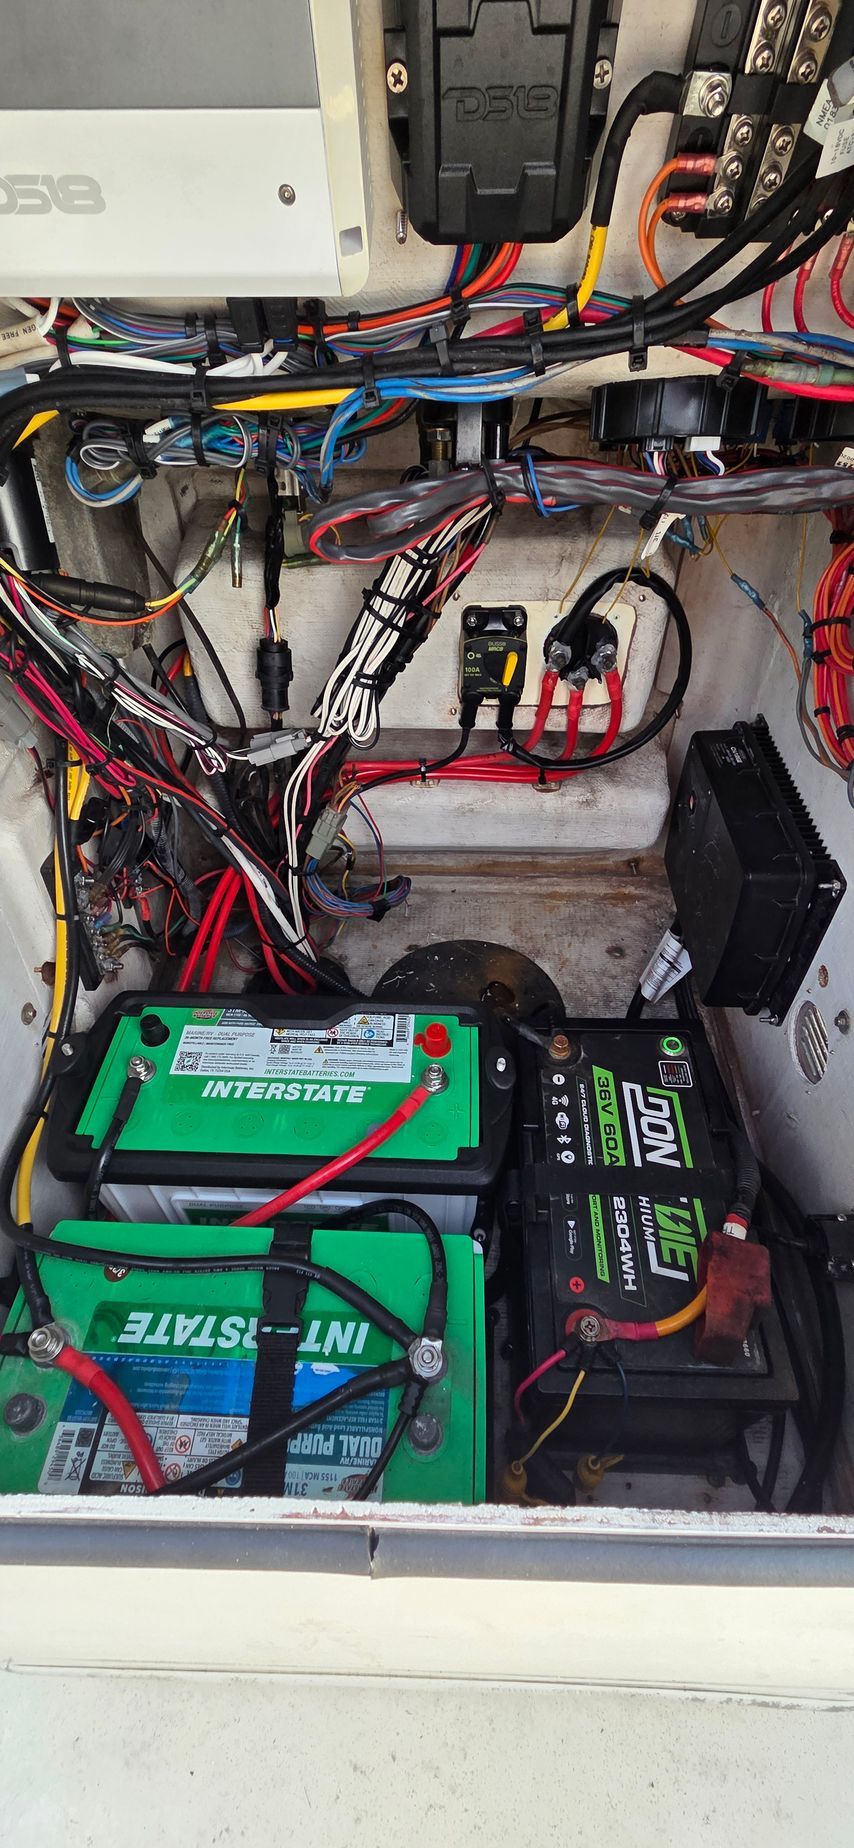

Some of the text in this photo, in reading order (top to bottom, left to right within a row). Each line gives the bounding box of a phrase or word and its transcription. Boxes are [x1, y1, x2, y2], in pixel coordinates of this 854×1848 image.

[442, 84, 560, 122] DS18
[816, 99, 832, 126] NMEA
[0, 174, 106, 215] S18
[1, 330, 19, 340] FREE
[264, 1068, 355, 1077] INTERSTATEBATTERIES.COM
[201, 1080, 366, 1103] INTERSTATE
[552, 1096, 559, 1105] 4G
[598, 1076, 613, 1116] 36V
[628, 1090, 681, 1168] DON
[638, 1196, 656, 1241] HIUM
[596, 1228, 605, 1277] MONITORING
[613, 1197, 637, 1291] 2304WH
[117, 1312, 370, 1354] INTRSTATE
[339, 1434, 382, 1457] DUAL
[120, 1484, 146, 1493] ISON
[304, 1472, 319, 1480] MCA
[321, 1473, 338, 1481] 1155
